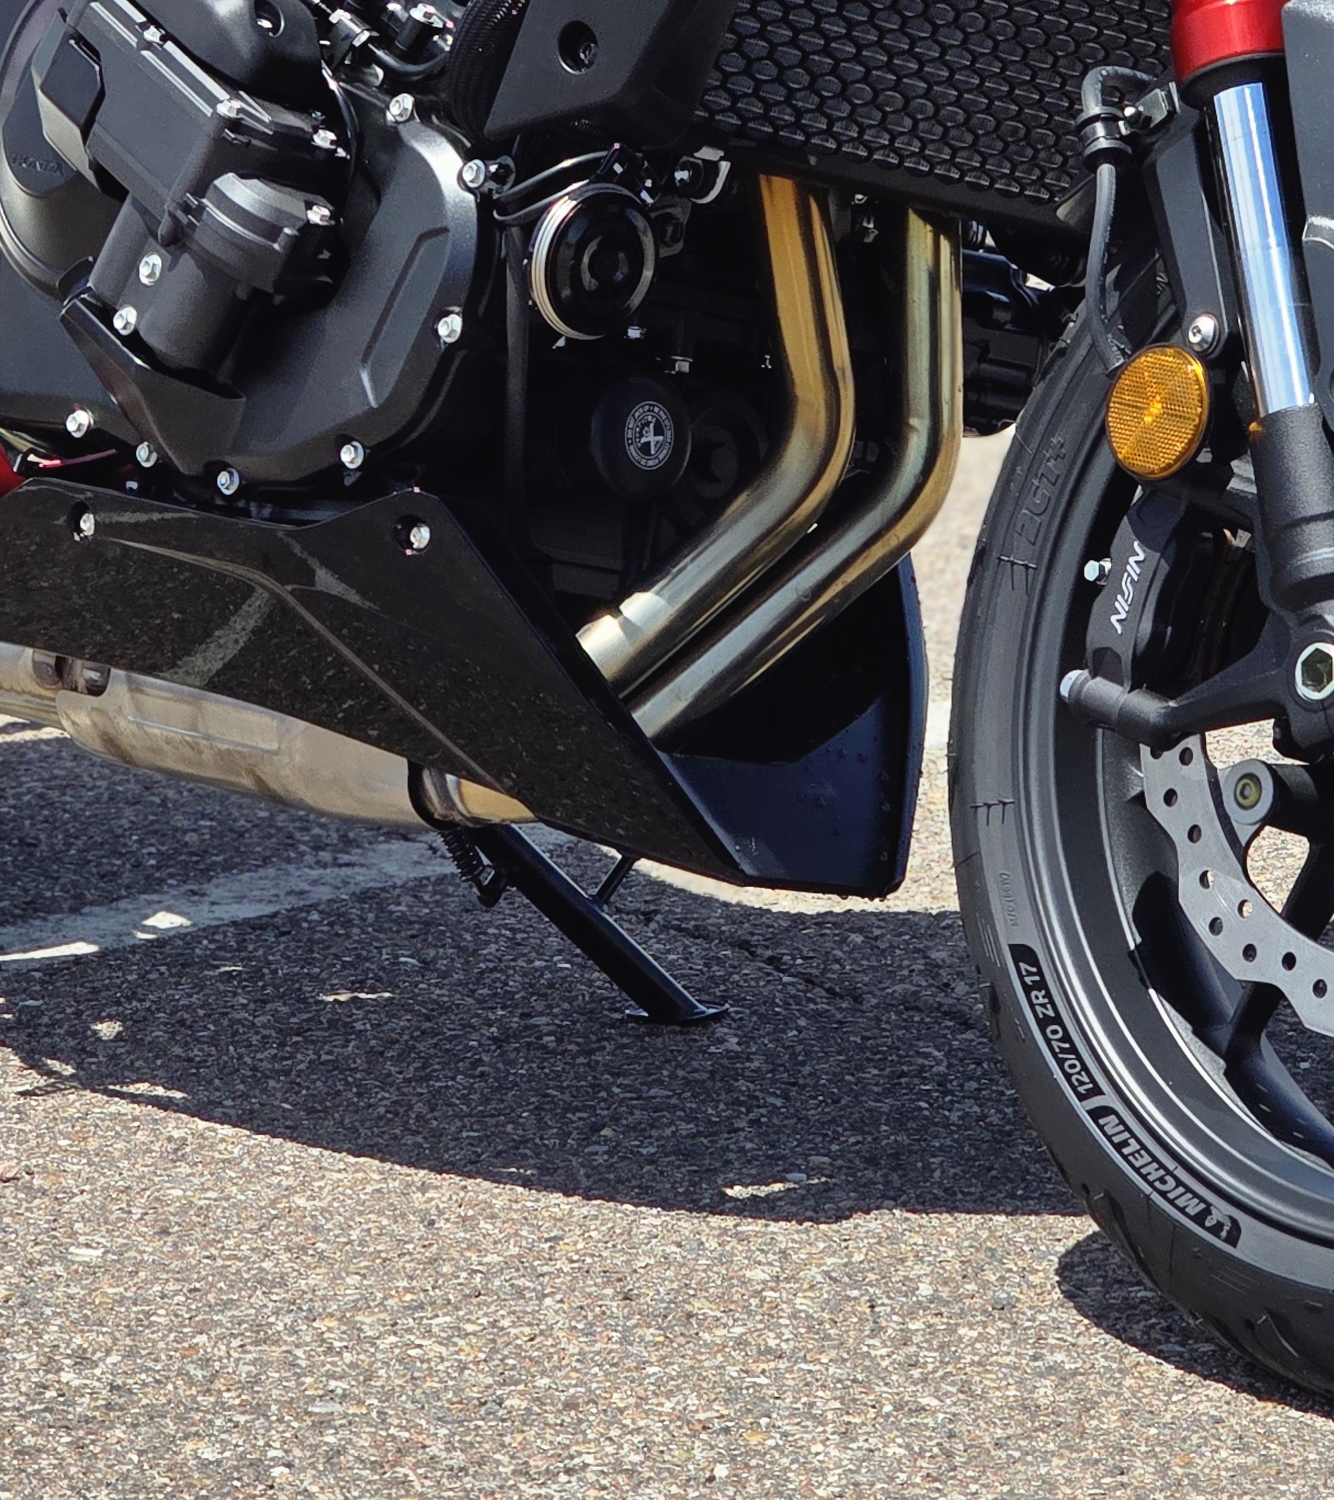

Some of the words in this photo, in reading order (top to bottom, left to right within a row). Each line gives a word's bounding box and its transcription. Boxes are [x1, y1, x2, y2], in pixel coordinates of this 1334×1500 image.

[1109, 540, 1147, 635] NISSIN
[1018, 960, 1039, 986] 17
[1030, 989, 1056, 1018] ZR
[1047, 1024, 1095, 1095] 120/70
[1097, 1113, 1207, 1217] MICHELIN
